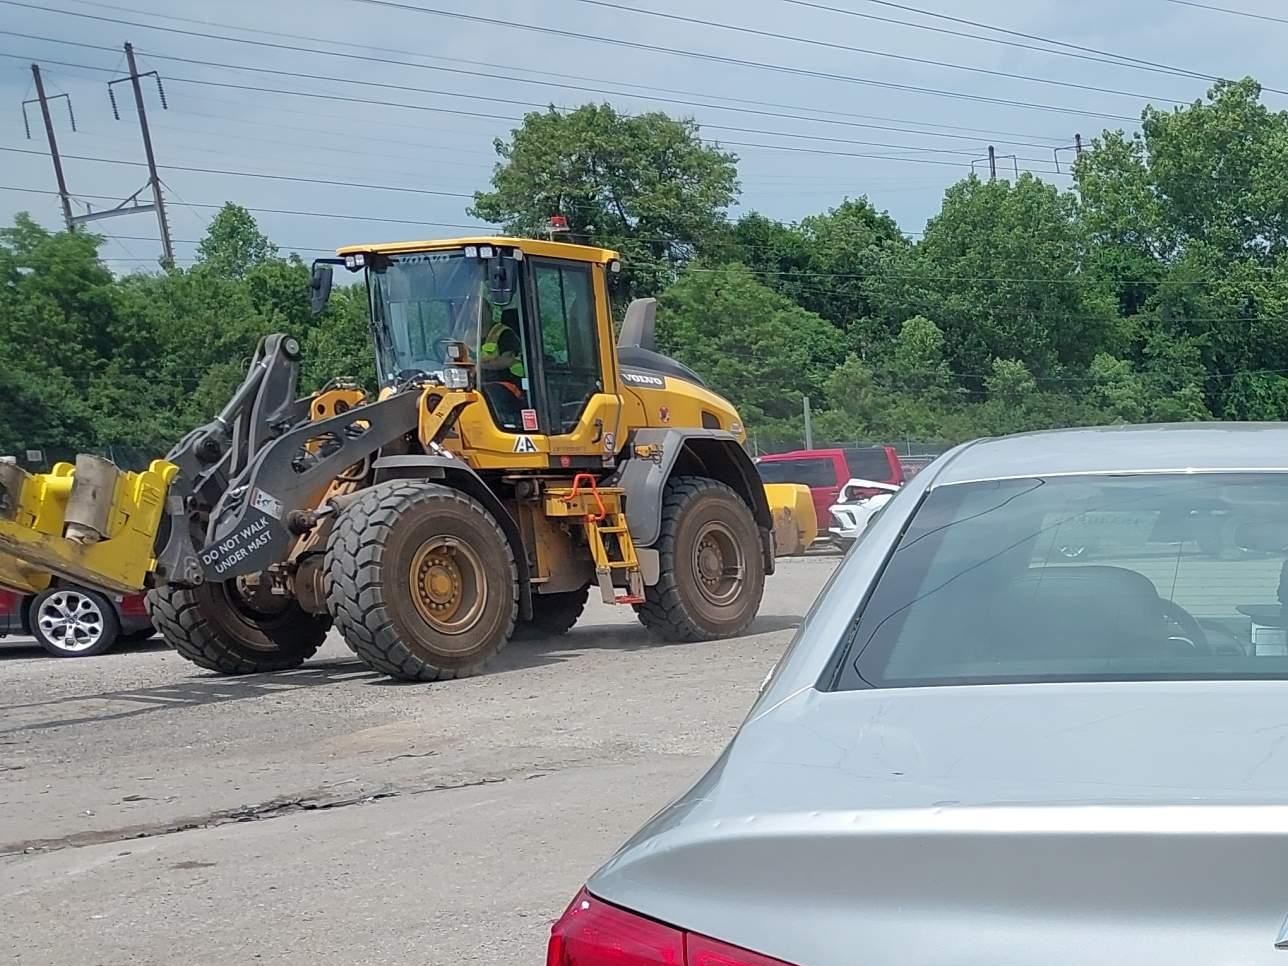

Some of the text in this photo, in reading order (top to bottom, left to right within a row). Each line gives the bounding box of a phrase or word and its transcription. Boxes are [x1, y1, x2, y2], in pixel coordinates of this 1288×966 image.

[399, 253, 450, 264] VOLVO
[621, 373, 663, 385] VOLVO
[202, 516, 269, 565] DO NOT WALK
[214, 530, 273, 573] UNDER MAST
